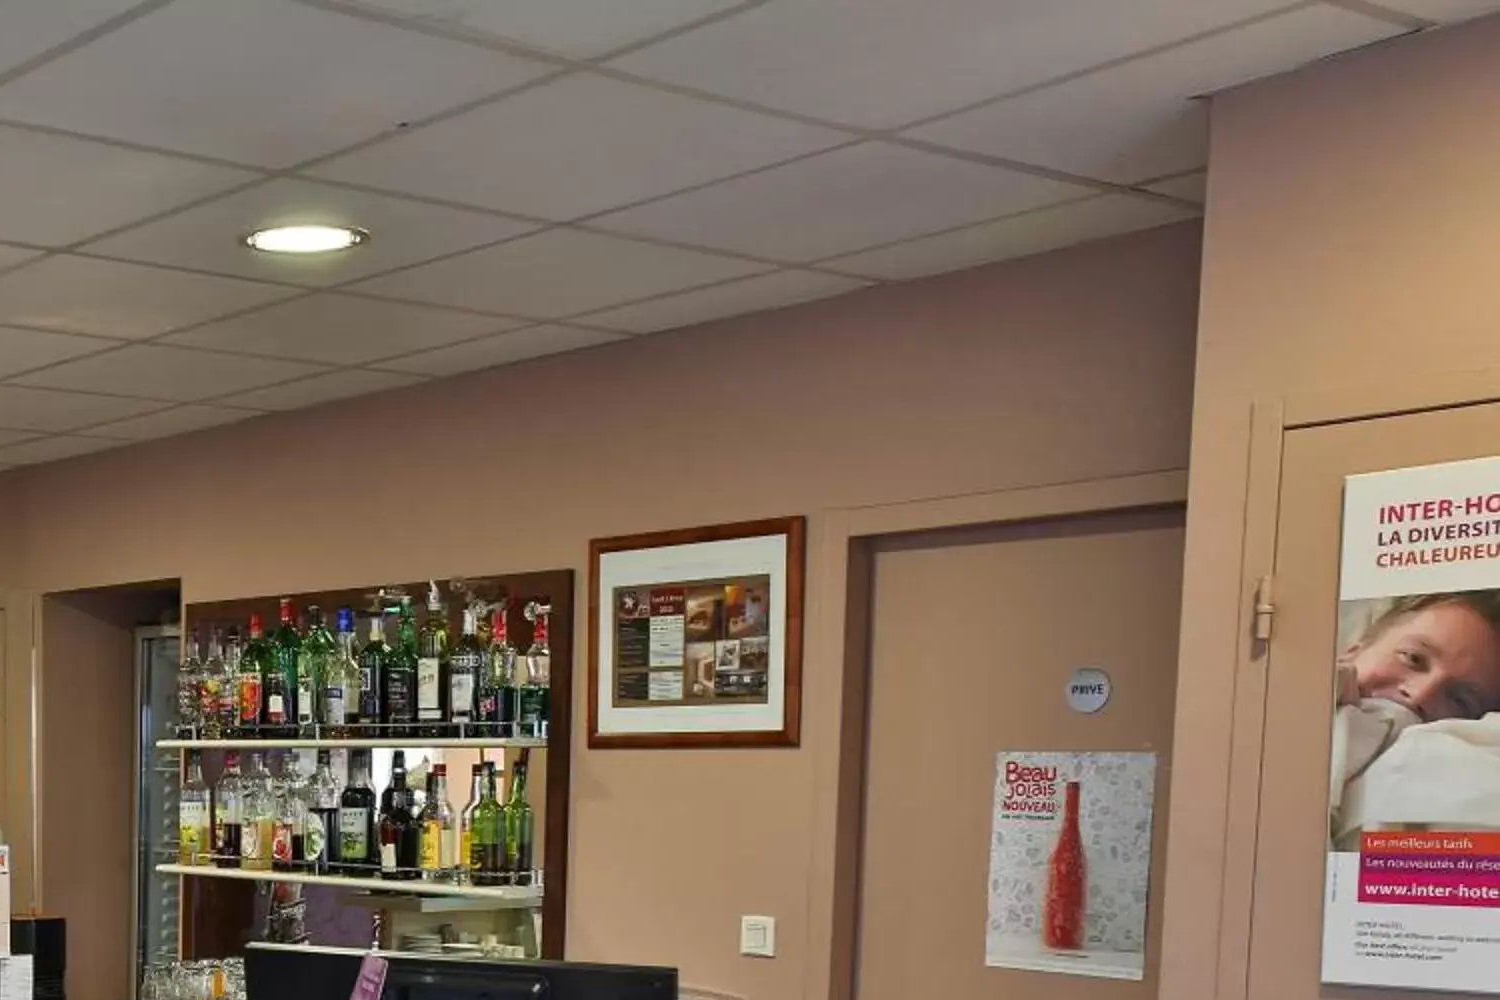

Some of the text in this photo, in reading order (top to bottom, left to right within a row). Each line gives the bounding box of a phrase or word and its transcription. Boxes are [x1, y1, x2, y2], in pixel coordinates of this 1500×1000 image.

[1379, 493, 1500, 524] INTER-HO
[1378, 530, 1402, 546] LA
[1376, 543, 1500, 568] CHALEUREU
[1005, 760, 1058, 783] Beau
[1002, 801, 1055, 812] NOUVEAU
[1387, 837, 1441, 849] meilleurs
[1443, 837, 1473, 849] tarifs
[1365, 856, 1385, 868] Les
[1457, 858, 1473, 870] du
